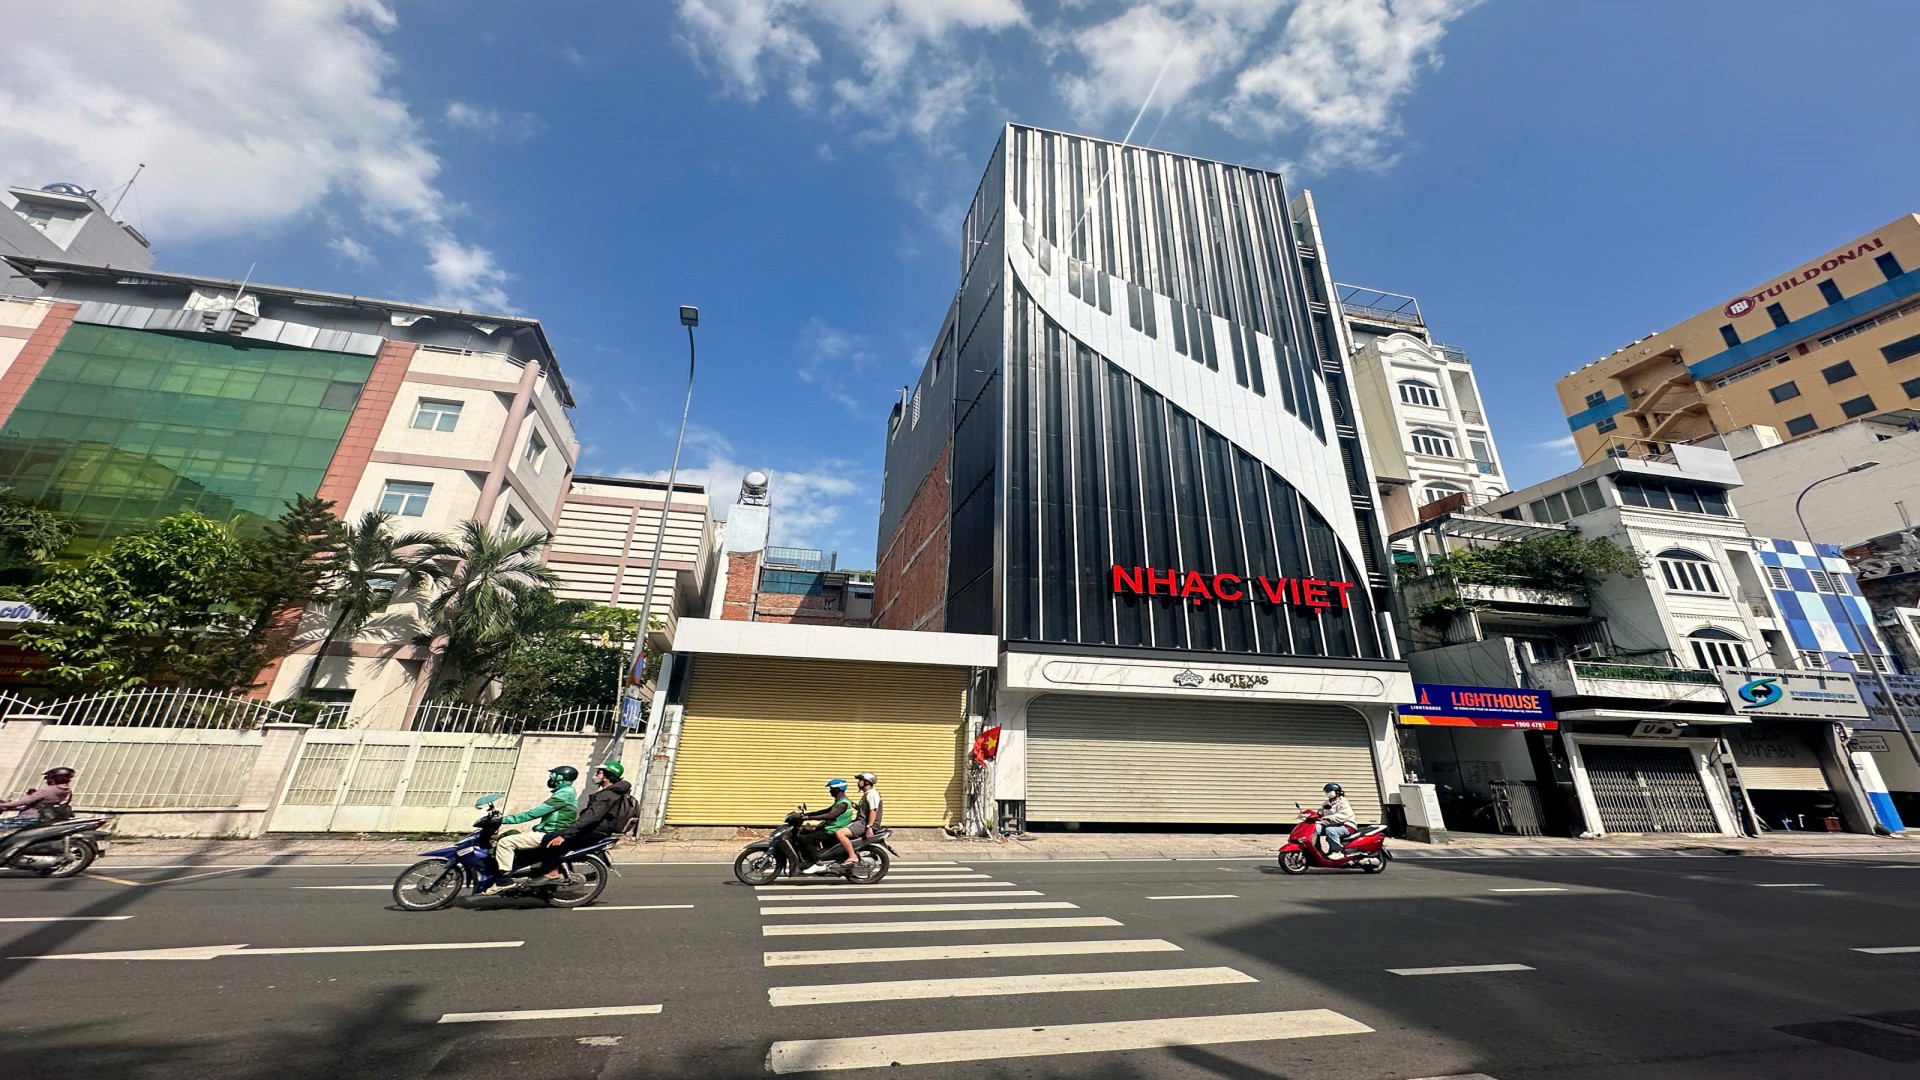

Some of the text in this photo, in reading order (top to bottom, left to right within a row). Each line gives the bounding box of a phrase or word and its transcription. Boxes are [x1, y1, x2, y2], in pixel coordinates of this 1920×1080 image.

[1752, 237, 1884, 303] TUILDONAI
[1112, 564, 1354, 614] NHẠC VIỆT
[1451, 691, 1542, 709] LIGHTHOUSE
